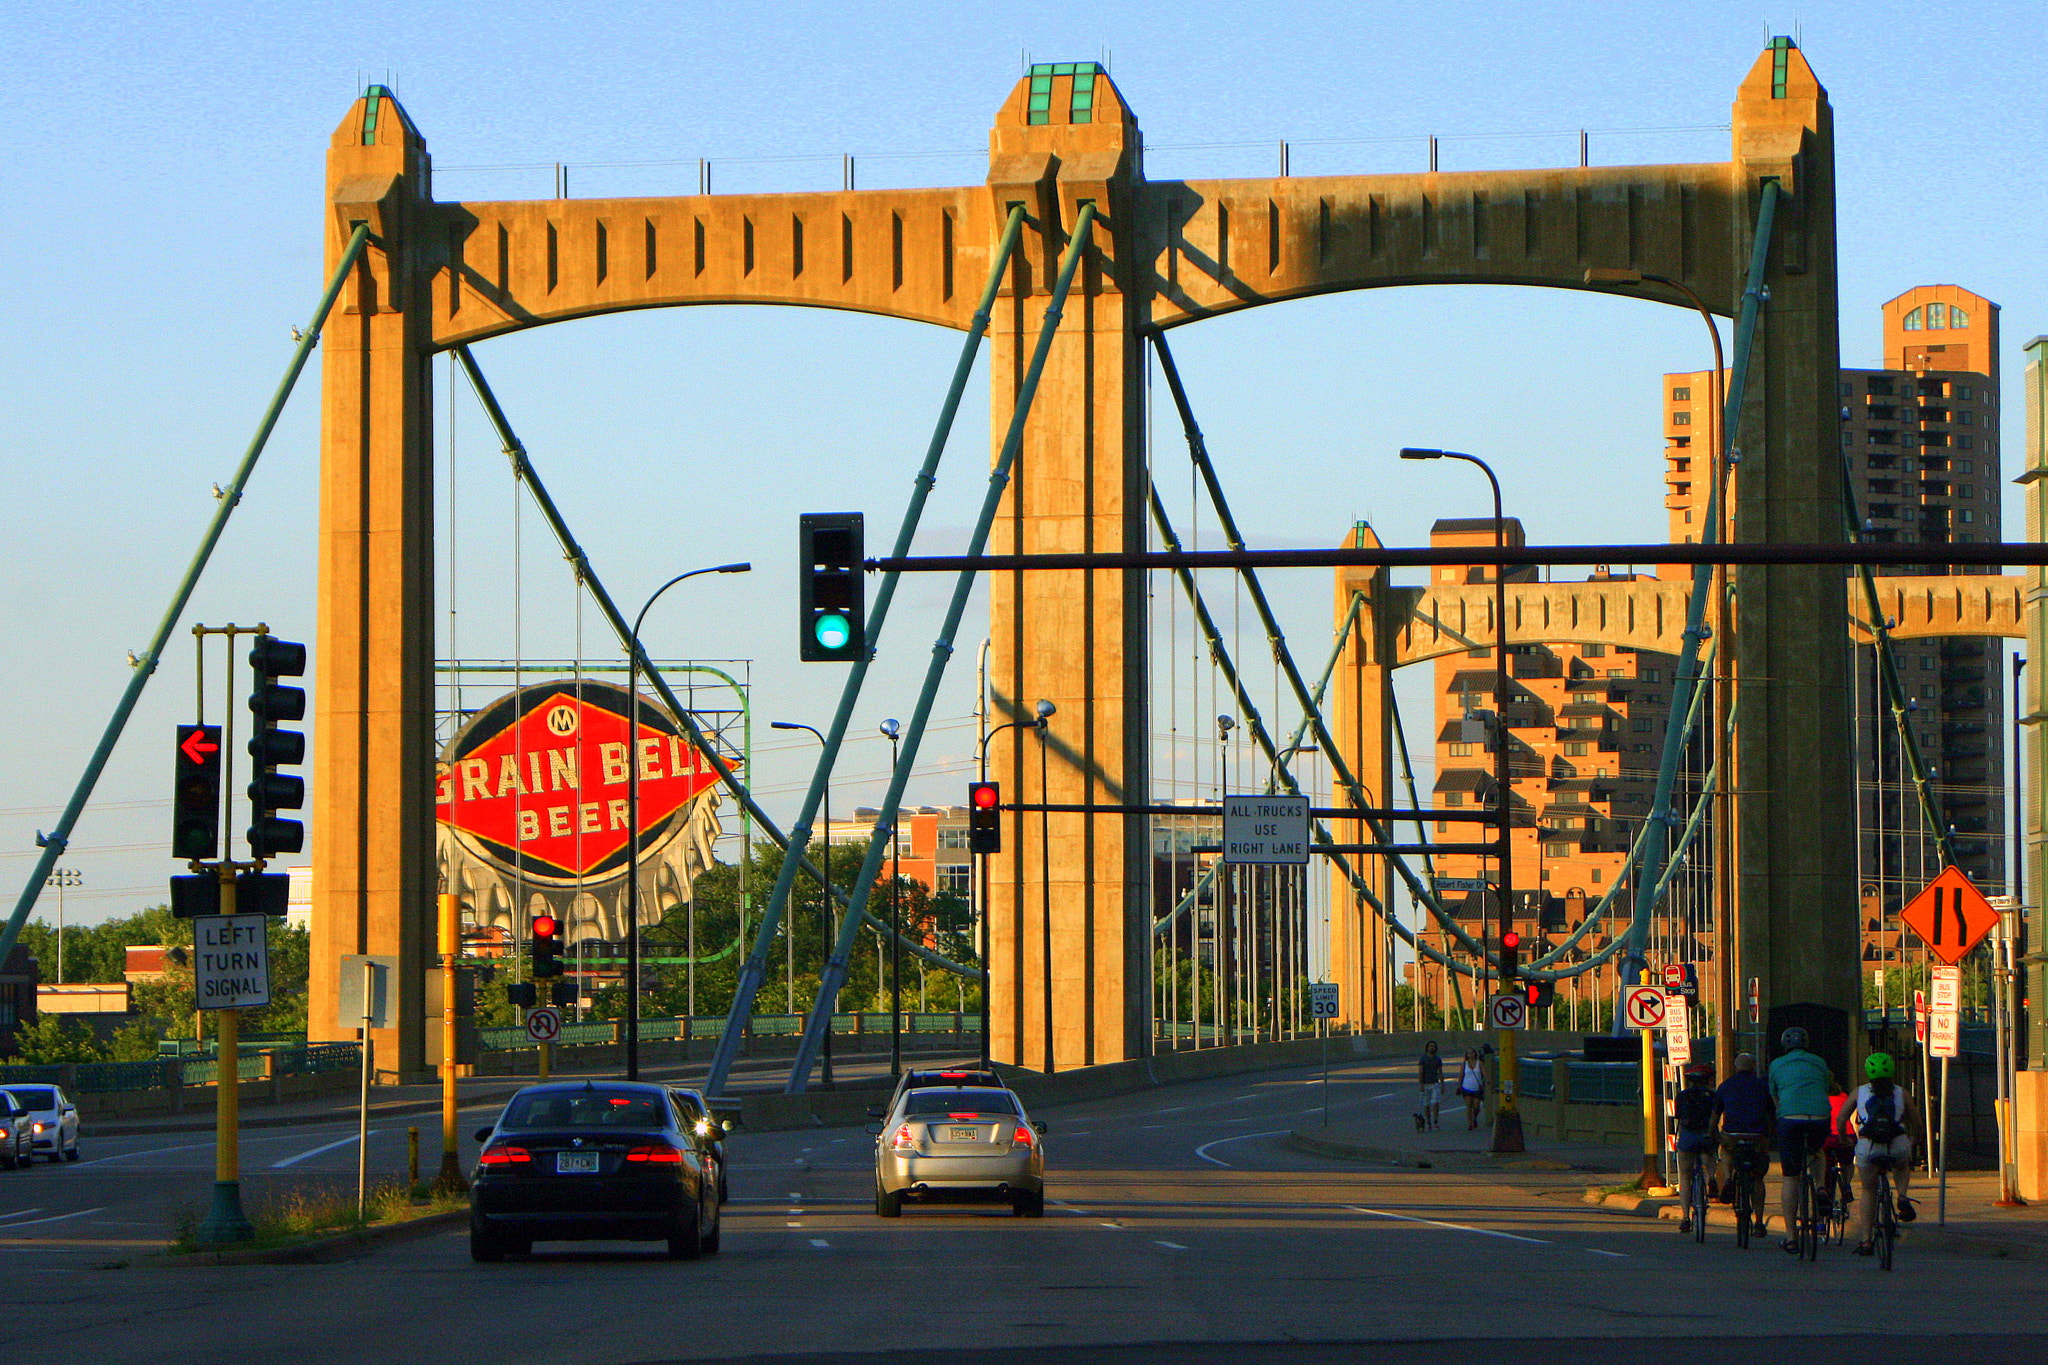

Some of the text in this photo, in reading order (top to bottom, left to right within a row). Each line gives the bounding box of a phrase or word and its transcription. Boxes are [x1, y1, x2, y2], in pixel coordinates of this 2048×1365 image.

[1231, 805, 1302, 817] ALL TRUCKS
[516, 799, 630, 841] BEER
[1255, 824, 1277, 835] USE
[1231, 843, 1302, 854] RIGHT LANE
[206, 927, 256, 945] LEFT
[203, 952, 258, 971] TURN
[205, 977, 262, 997] SIGNAL
[1937, 991, 1952, 999] STOP
[1314, 1002, 1336, 1014] 30
[1938, 1018, 1949, 1029] NO
[1673, 1035, 1683, 1044] NO
[1931, 1032, 1954, 1040] PARKING
